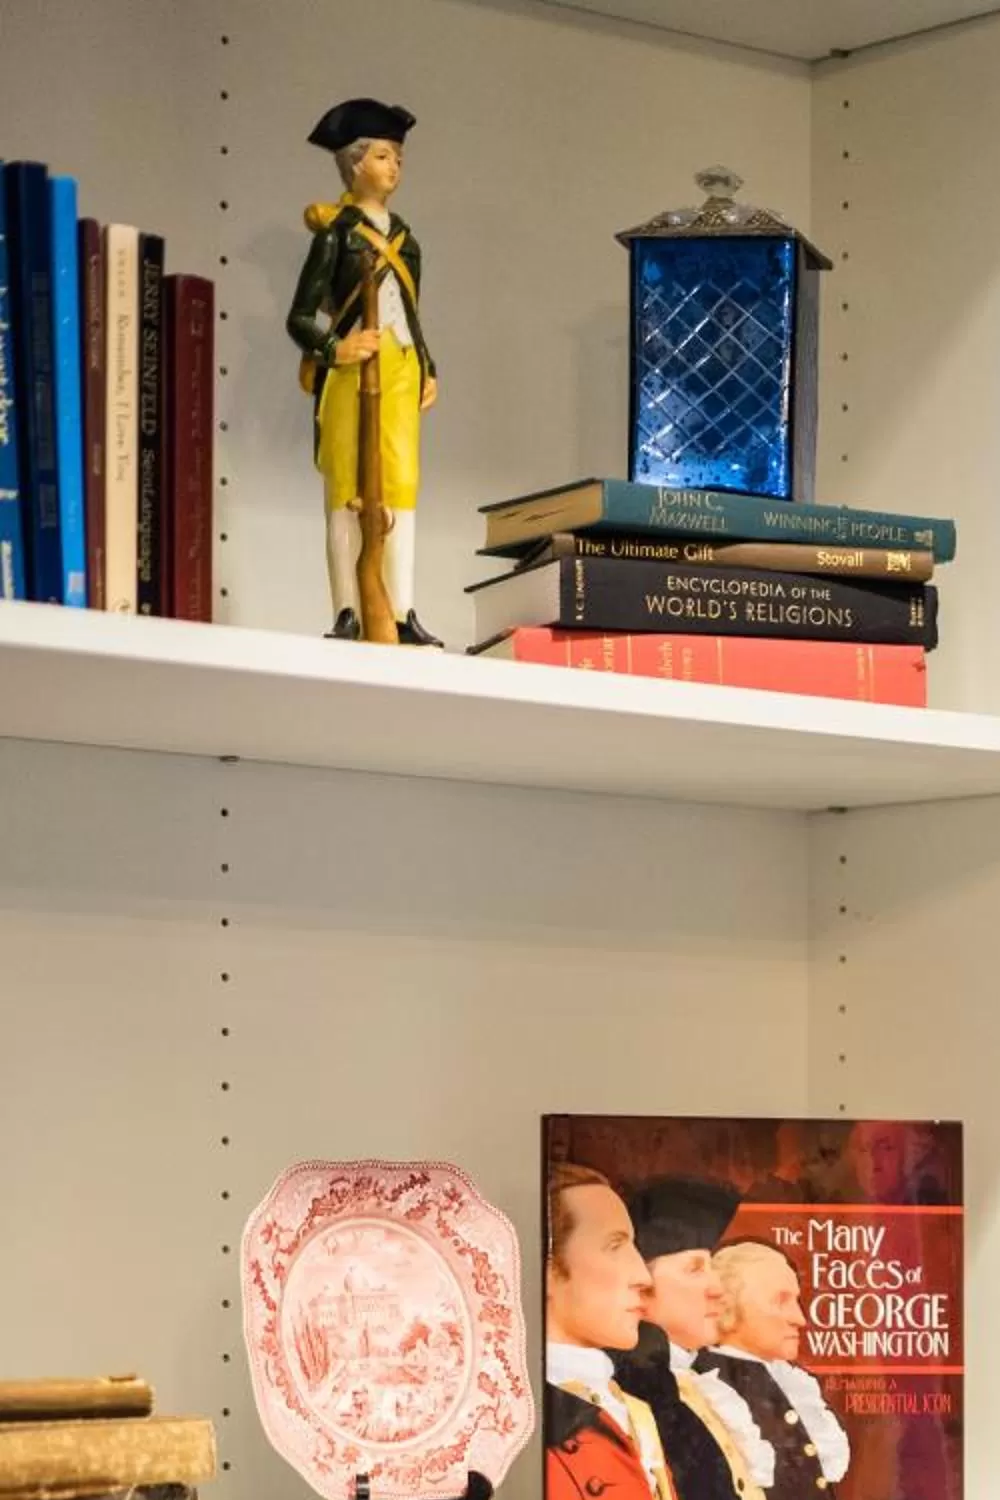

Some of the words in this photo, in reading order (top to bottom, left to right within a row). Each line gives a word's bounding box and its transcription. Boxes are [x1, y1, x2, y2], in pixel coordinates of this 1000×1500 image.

[142, 257, 160, 324] JERRY
[141, 326, 159, 436] SEINFELD
[657, 485, 700, 509] JOHN
[137, 447, 155, 583] SeinLanguage
[649, 507, 729, 532] MAXWELL
[851, 521, 908, 543] PEOPLE
[576, 539, 605, 557] The
[611, 539, 679, 560] Ultimate
[684, 543, 714, 562] Gift
[816, 551, 864, 568] Stovall
[667, 575, 787, 598] ENCYCLOPEDIA
[791, 587, 807, 600] OF
[811, 588, 832, 601] THE
[645, 595, 737, 620] WORLD'S
[745, 602, 854, 628] RELIGIONS
[771, 1226, 803, 1245] The
[807, 1219, 886, 1257] Many
[813, 1252, 904, 1291] Faces
[905, 1266, 923, 1285] of
[809, 1293, 949, 1330] GEORGE
[807, 1330, 950, 1359] WASHINGTON
[844, 1391, 921, 1414] PRESIDENTIAL
